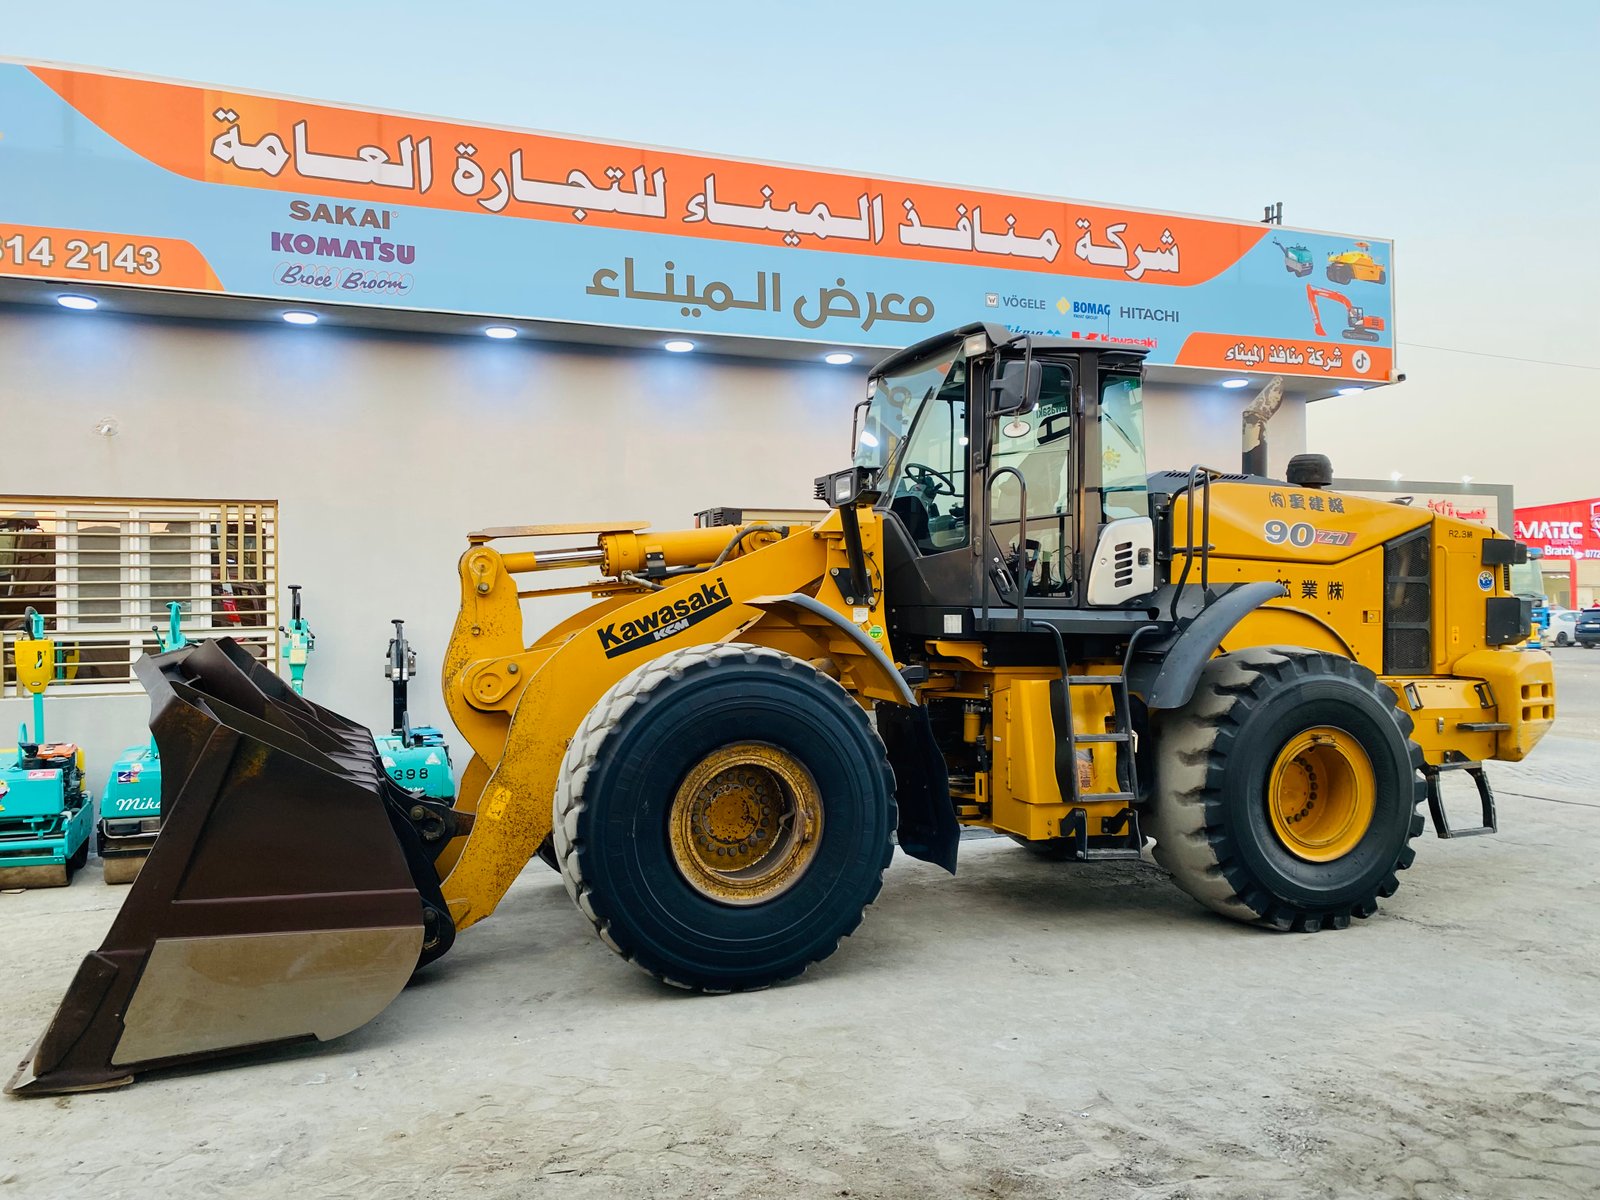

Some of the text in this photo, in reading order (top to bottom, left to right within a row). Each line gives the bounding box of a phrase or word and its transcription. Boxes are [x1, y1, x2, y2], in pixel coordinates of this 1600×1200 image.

[211, 107, 1180, 280] شركة منافذ الميناء للتجارة العامة
[289, 200, 390, 230] SAKAI
[0, 234, 162, 276] 14 2143
[271, 231, 416, 265] KOMATSU
[280, 265, 408, 290] Broce Broom
[586, 257, 935, 332] معرض الميناء
[1002, 295, 1046, 310] VÖGELE
[1073, 301, 1111, 315] BOMAG
[1120, 306, 1180, 322] HITACHI
[1225, 342, 1342, 371] شركة منافذ الميناء
[1544, 545, 1575, 556] Branch
[597, 577, 729, 650] Kawasaki
[653, 618, 690, 641] KCM
[393, 768, 429, 780] 398
